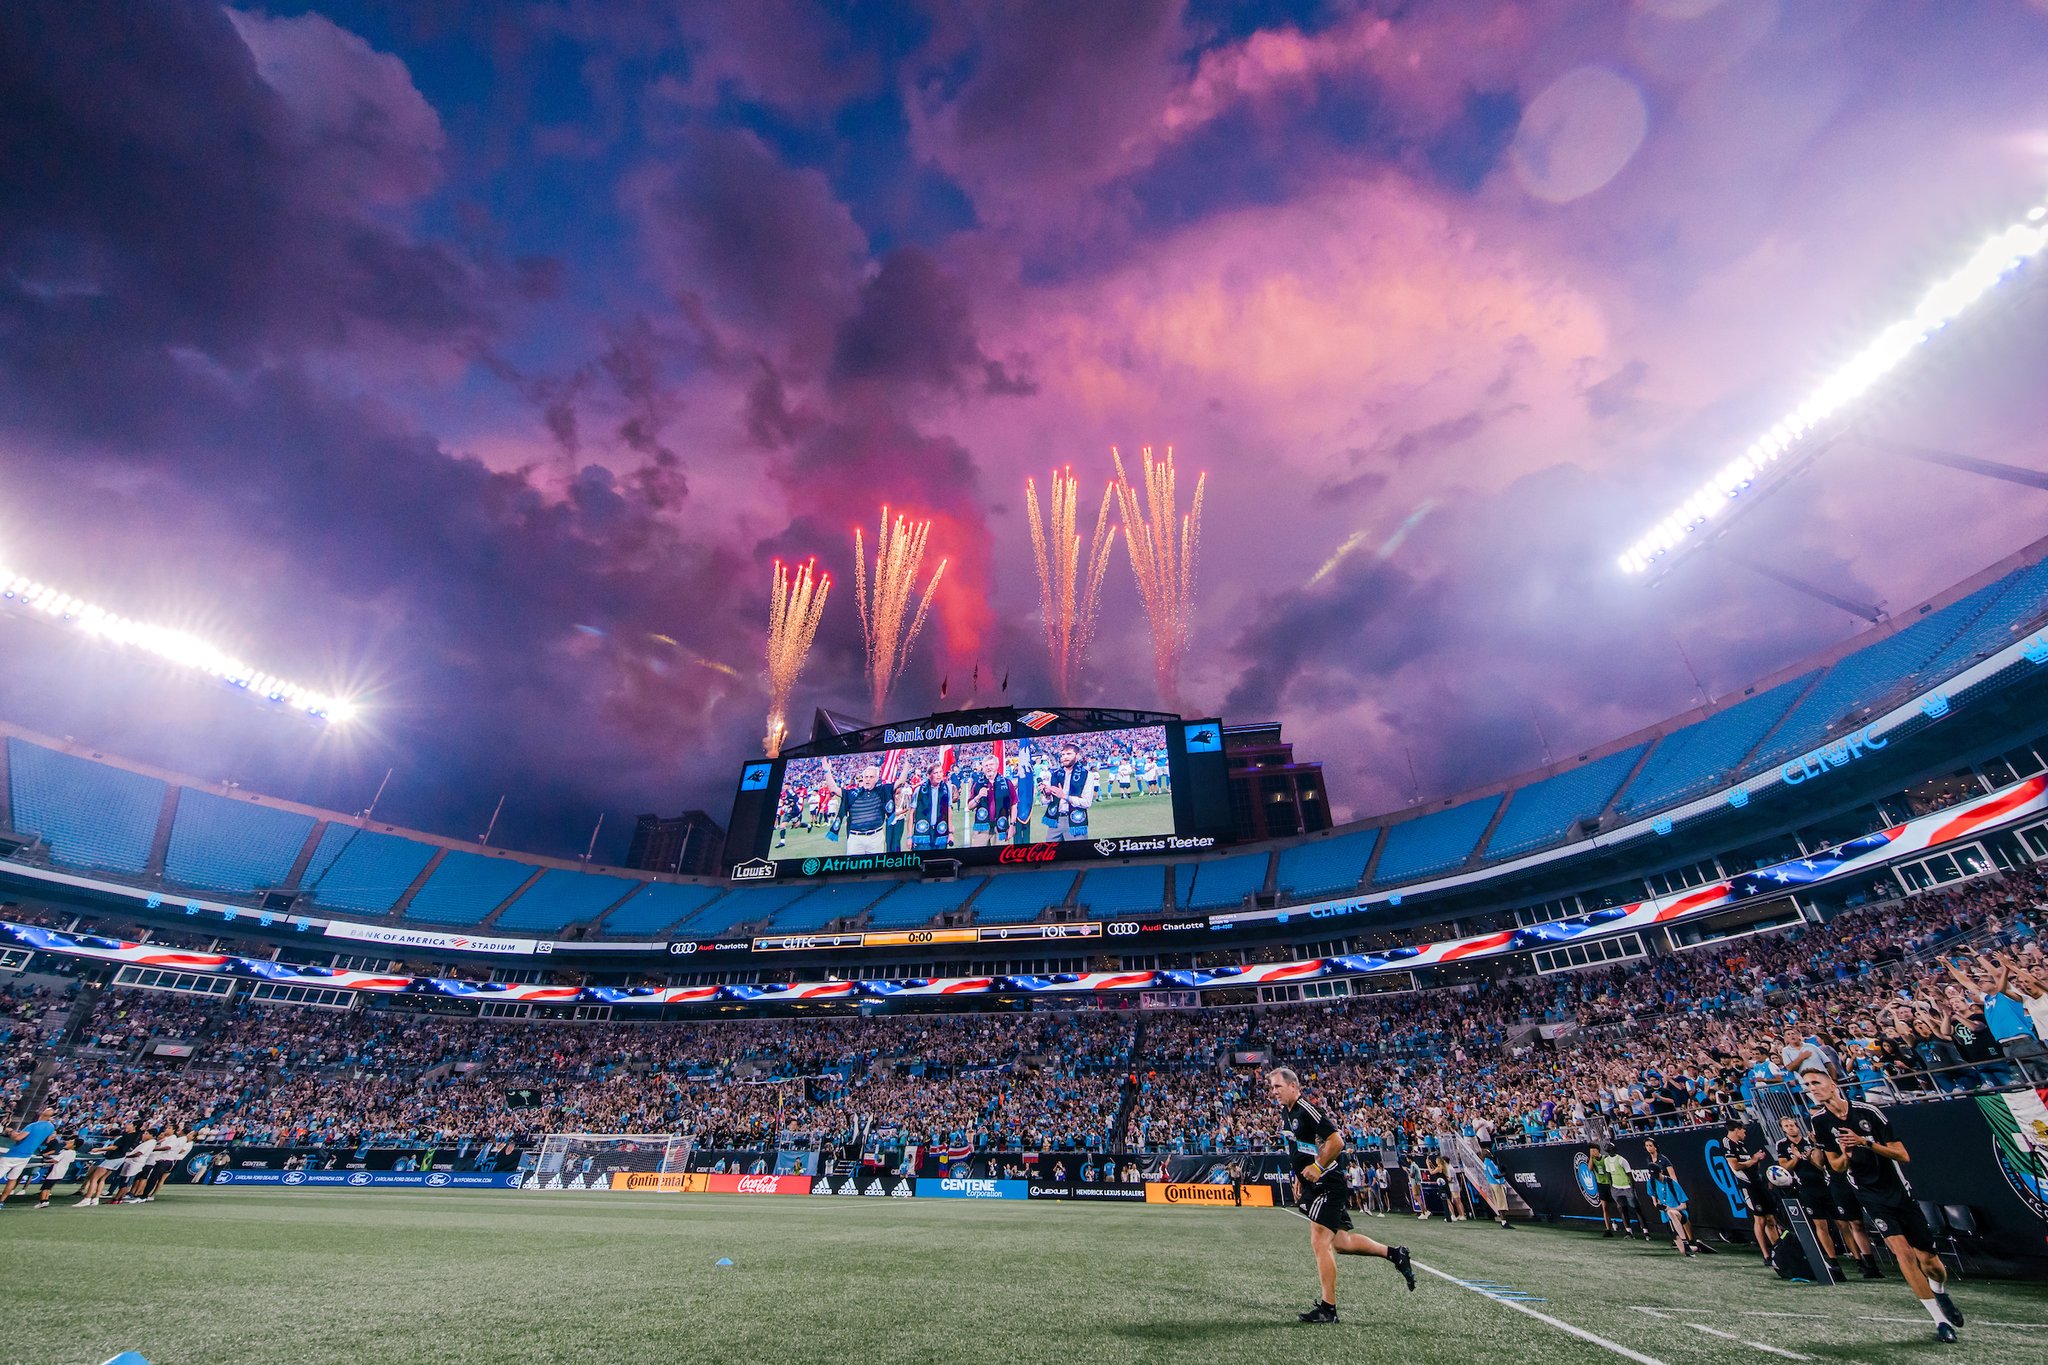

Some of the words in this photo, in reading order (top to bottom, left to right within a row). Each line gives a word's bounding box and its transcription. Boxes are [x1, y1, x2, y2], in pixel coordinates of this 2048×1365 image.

[884, 727, 924, 744] Bank
[925, 724, 942, 740] of
[943, 720, 1011, 739] America
[1119, 838, 1165, 852] Harris
[1167, 835, 1214, 849] Teeter
[1000, 842, 1059, 863] Coca-Cola
[822, 857, 873, 872] Atrium
[875, 853, 921, 868] Health
[737, 865, 772, 877] LOWE'S
[1040, 926, 1067, 938] TOR
[1162, 921, 1204, 931] Charlotte
[350, 929, 381, 939] BANK
[399, 935, 446, 946] AMERICA
[471, 942, 515, 951] STADIUM
[908, 933, 932, 943] 0:00
[1000, 929, 1007, 939] 0
[715, 942, 748, 950] Charlotte
[783, 937, 815, 949] CLTFC
[833, 936, 840, 946] 0
[286, 1172, 302, 1183] Ford
[352, 1173, 369, 1184] Ford
[429, 1174, 447, 1184] Ford
[627, 1174, 685, 1189] Continental
[737, 1175, 780, 1193] Coca-Cola
[941, 1179, 995, 1191] CENTENE
[1165, 1185, 1235, 1203] Continenta
